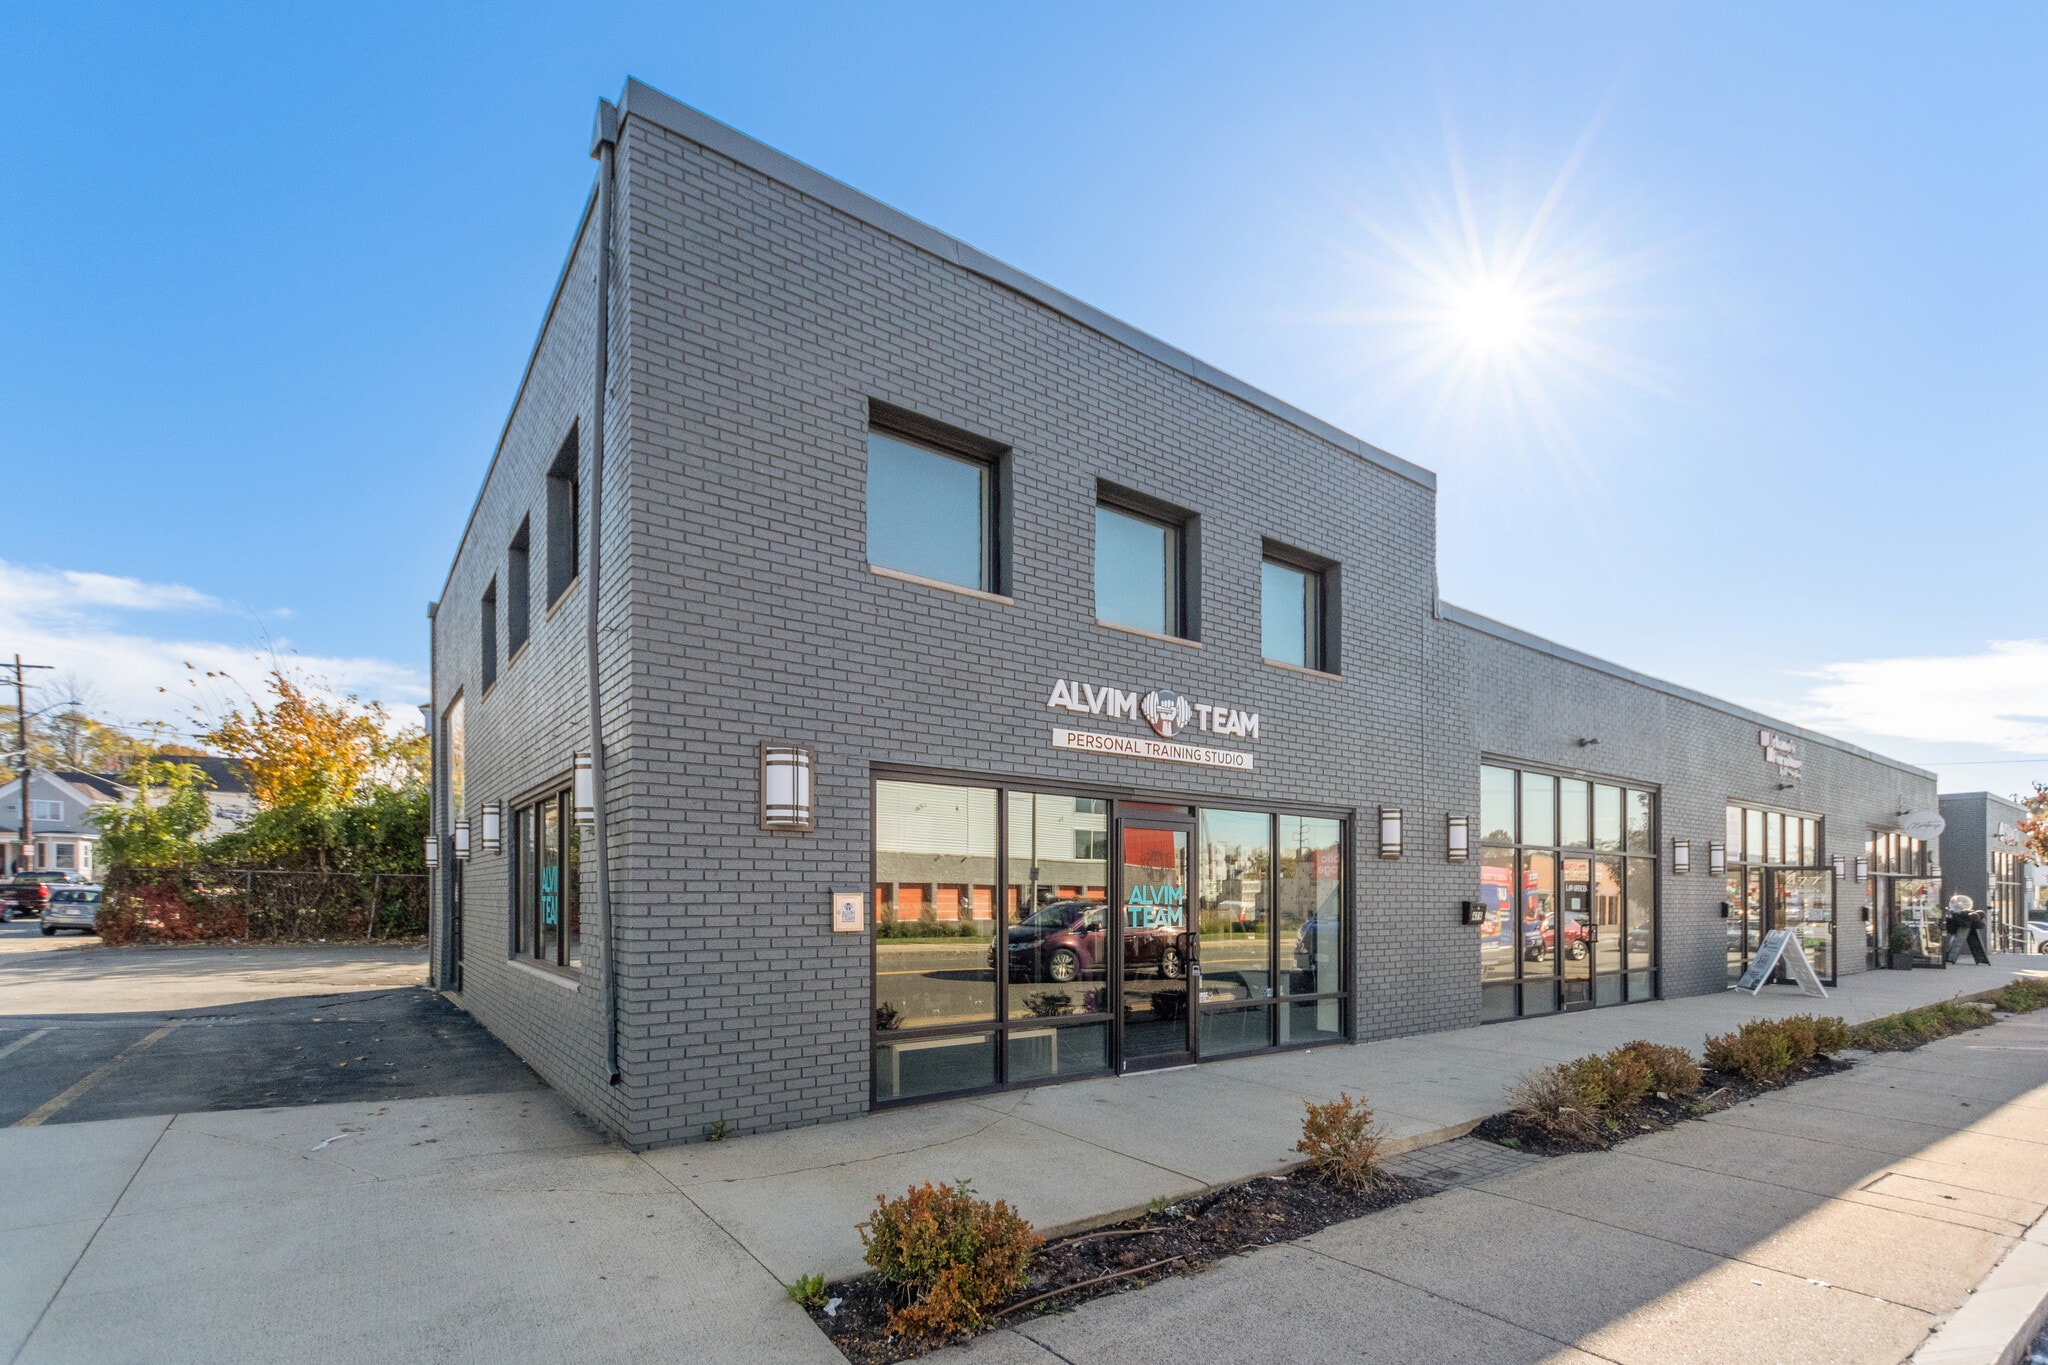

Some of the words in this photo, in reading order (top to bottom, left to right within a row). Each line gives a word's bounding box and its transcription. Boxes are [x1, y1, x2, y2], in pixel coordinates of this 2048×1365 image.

[1047, 679, 1137, 720] ALVIM
[1194, 703, 1259, 738] TEAM
[1067, 732, 1141, 754] PERSONAL
[1145, 742, 1202, 761] TRAINING
[1205, 750, 1244, 766] STUDIO
[541, 865, 559, 893] ALVI
[1784, 872, 1823, 886] 477
[1128, 884, 1183, 905] ALVIM
[1127, 906, 1183, 928] TEAM
